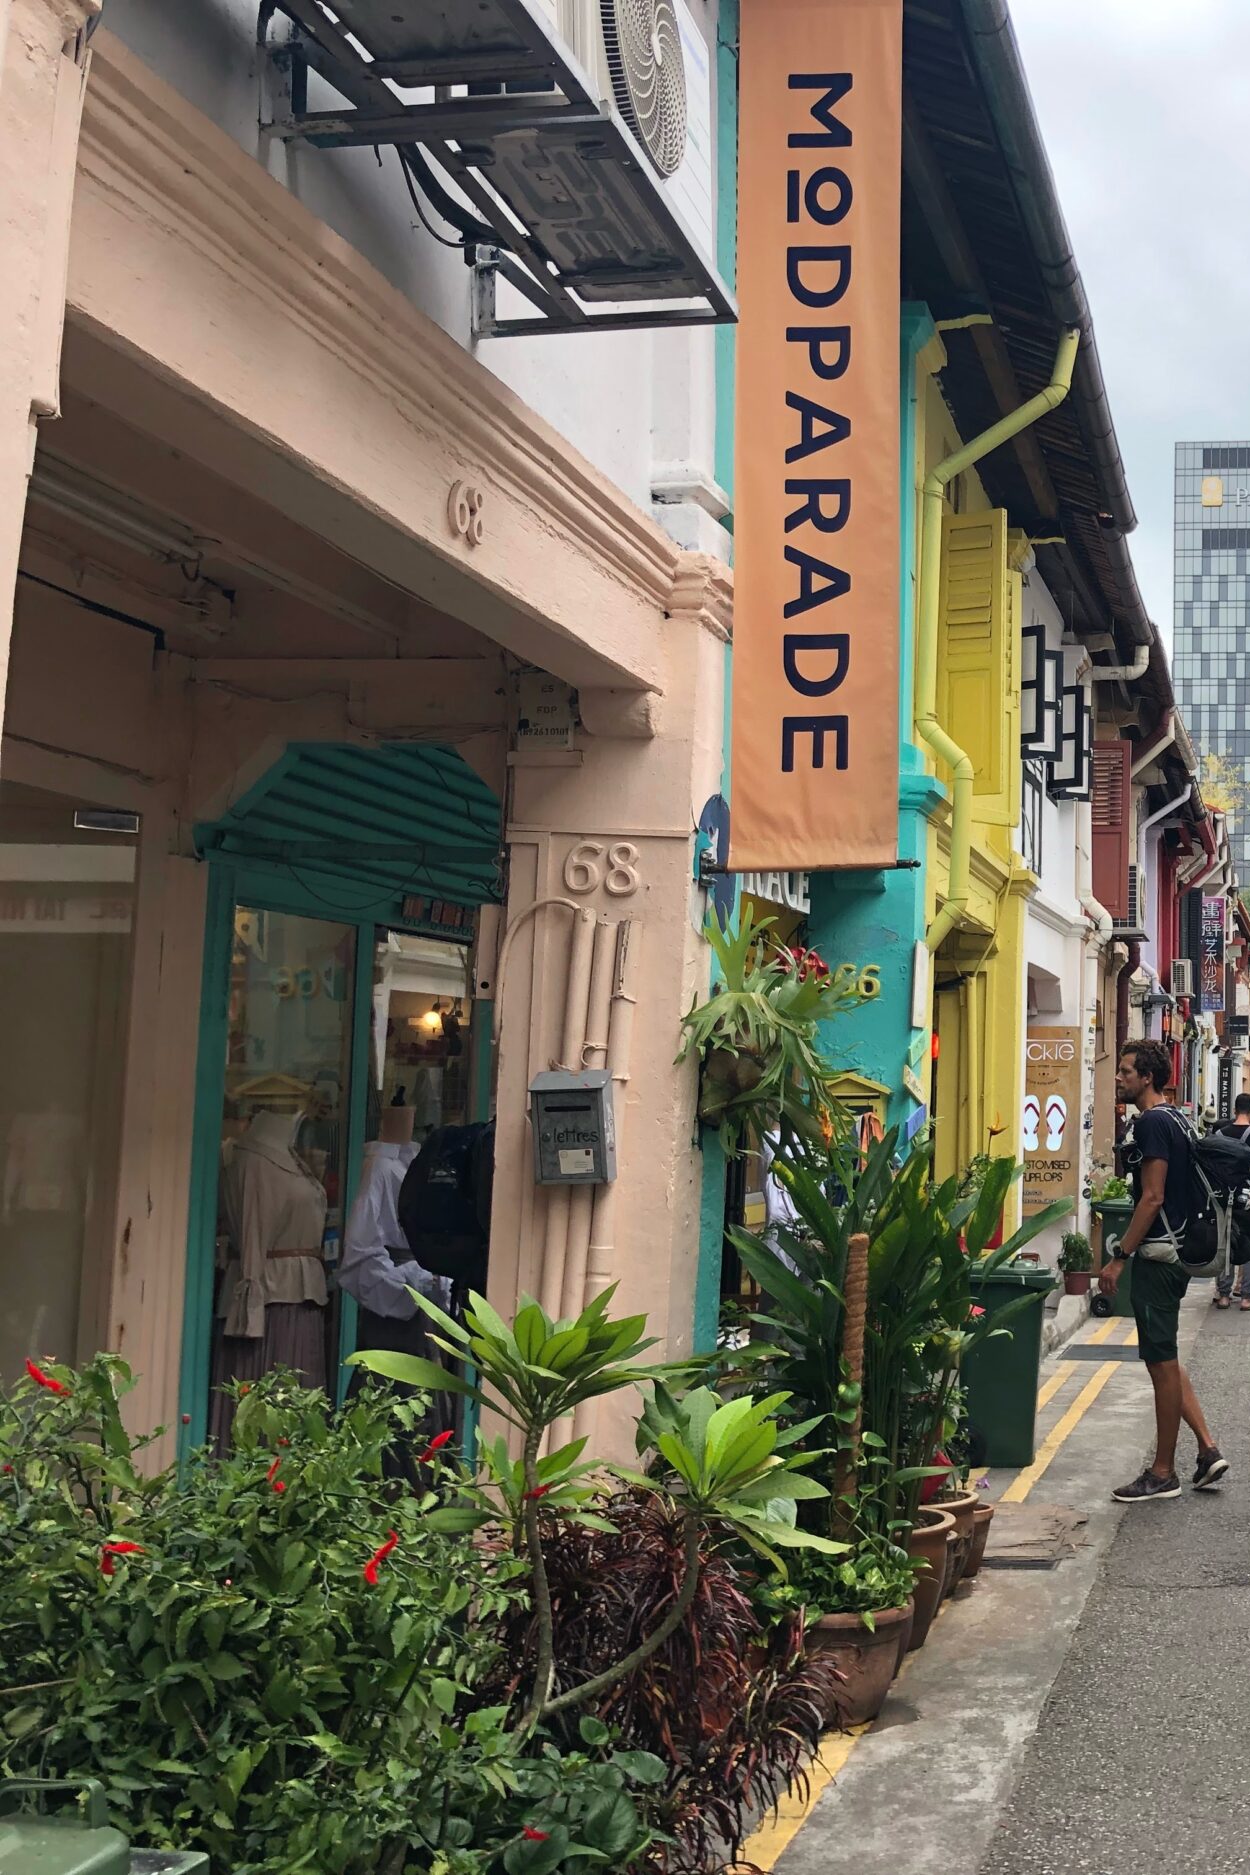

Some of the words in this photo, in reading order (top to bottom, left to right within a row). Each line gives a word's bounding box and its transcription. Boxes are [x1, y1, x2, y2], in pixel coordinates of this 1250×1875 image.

[447, 480, 484, 547] 68
[563, 841, 640, 897] 68
[835, 963, 881, 999] 66
[553, 1128, 600, 1143] lettres
